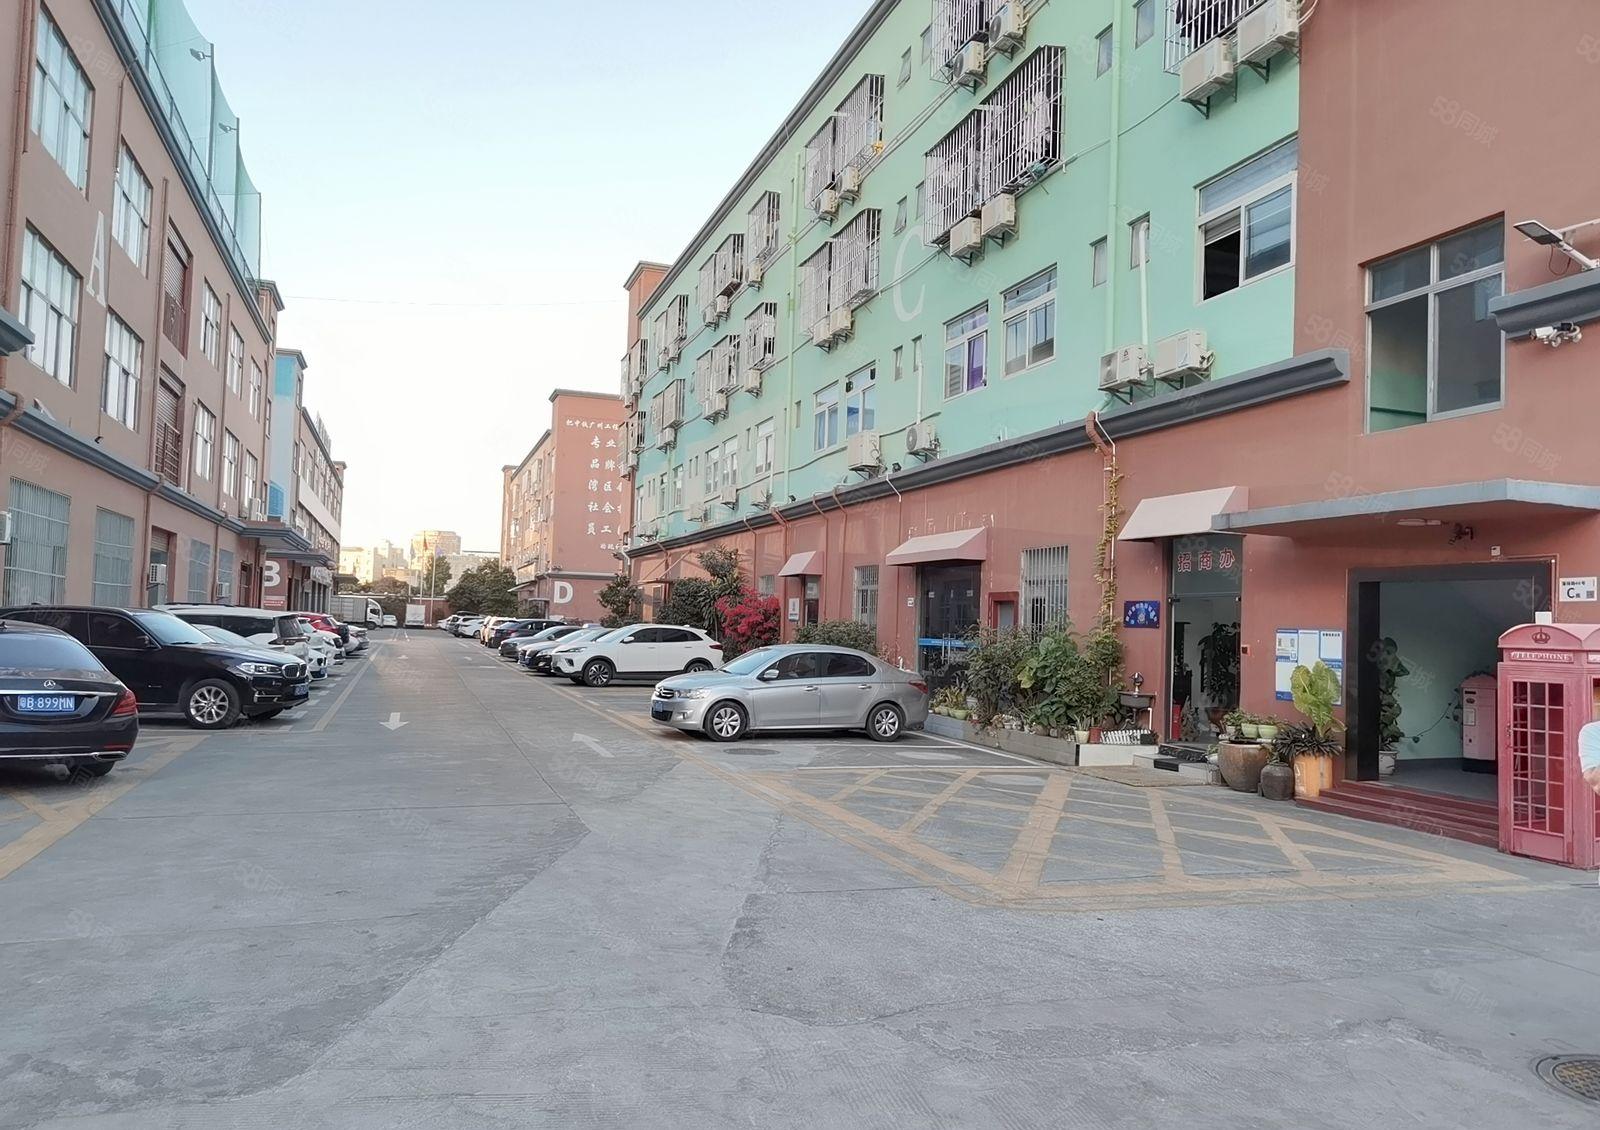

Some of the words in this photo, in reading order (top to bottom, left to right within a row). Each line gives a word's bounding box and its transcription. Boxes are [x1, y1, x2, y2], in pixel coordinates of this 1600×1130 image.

[86, 210, 106, 308] A
[892, 225, 926, 322] C
[586, 522, 621, 536] 员工
[1177, 547, 1236, 573] 招商办
[264, 560, 281, 587] B
[553, 581, 574, 604] D
